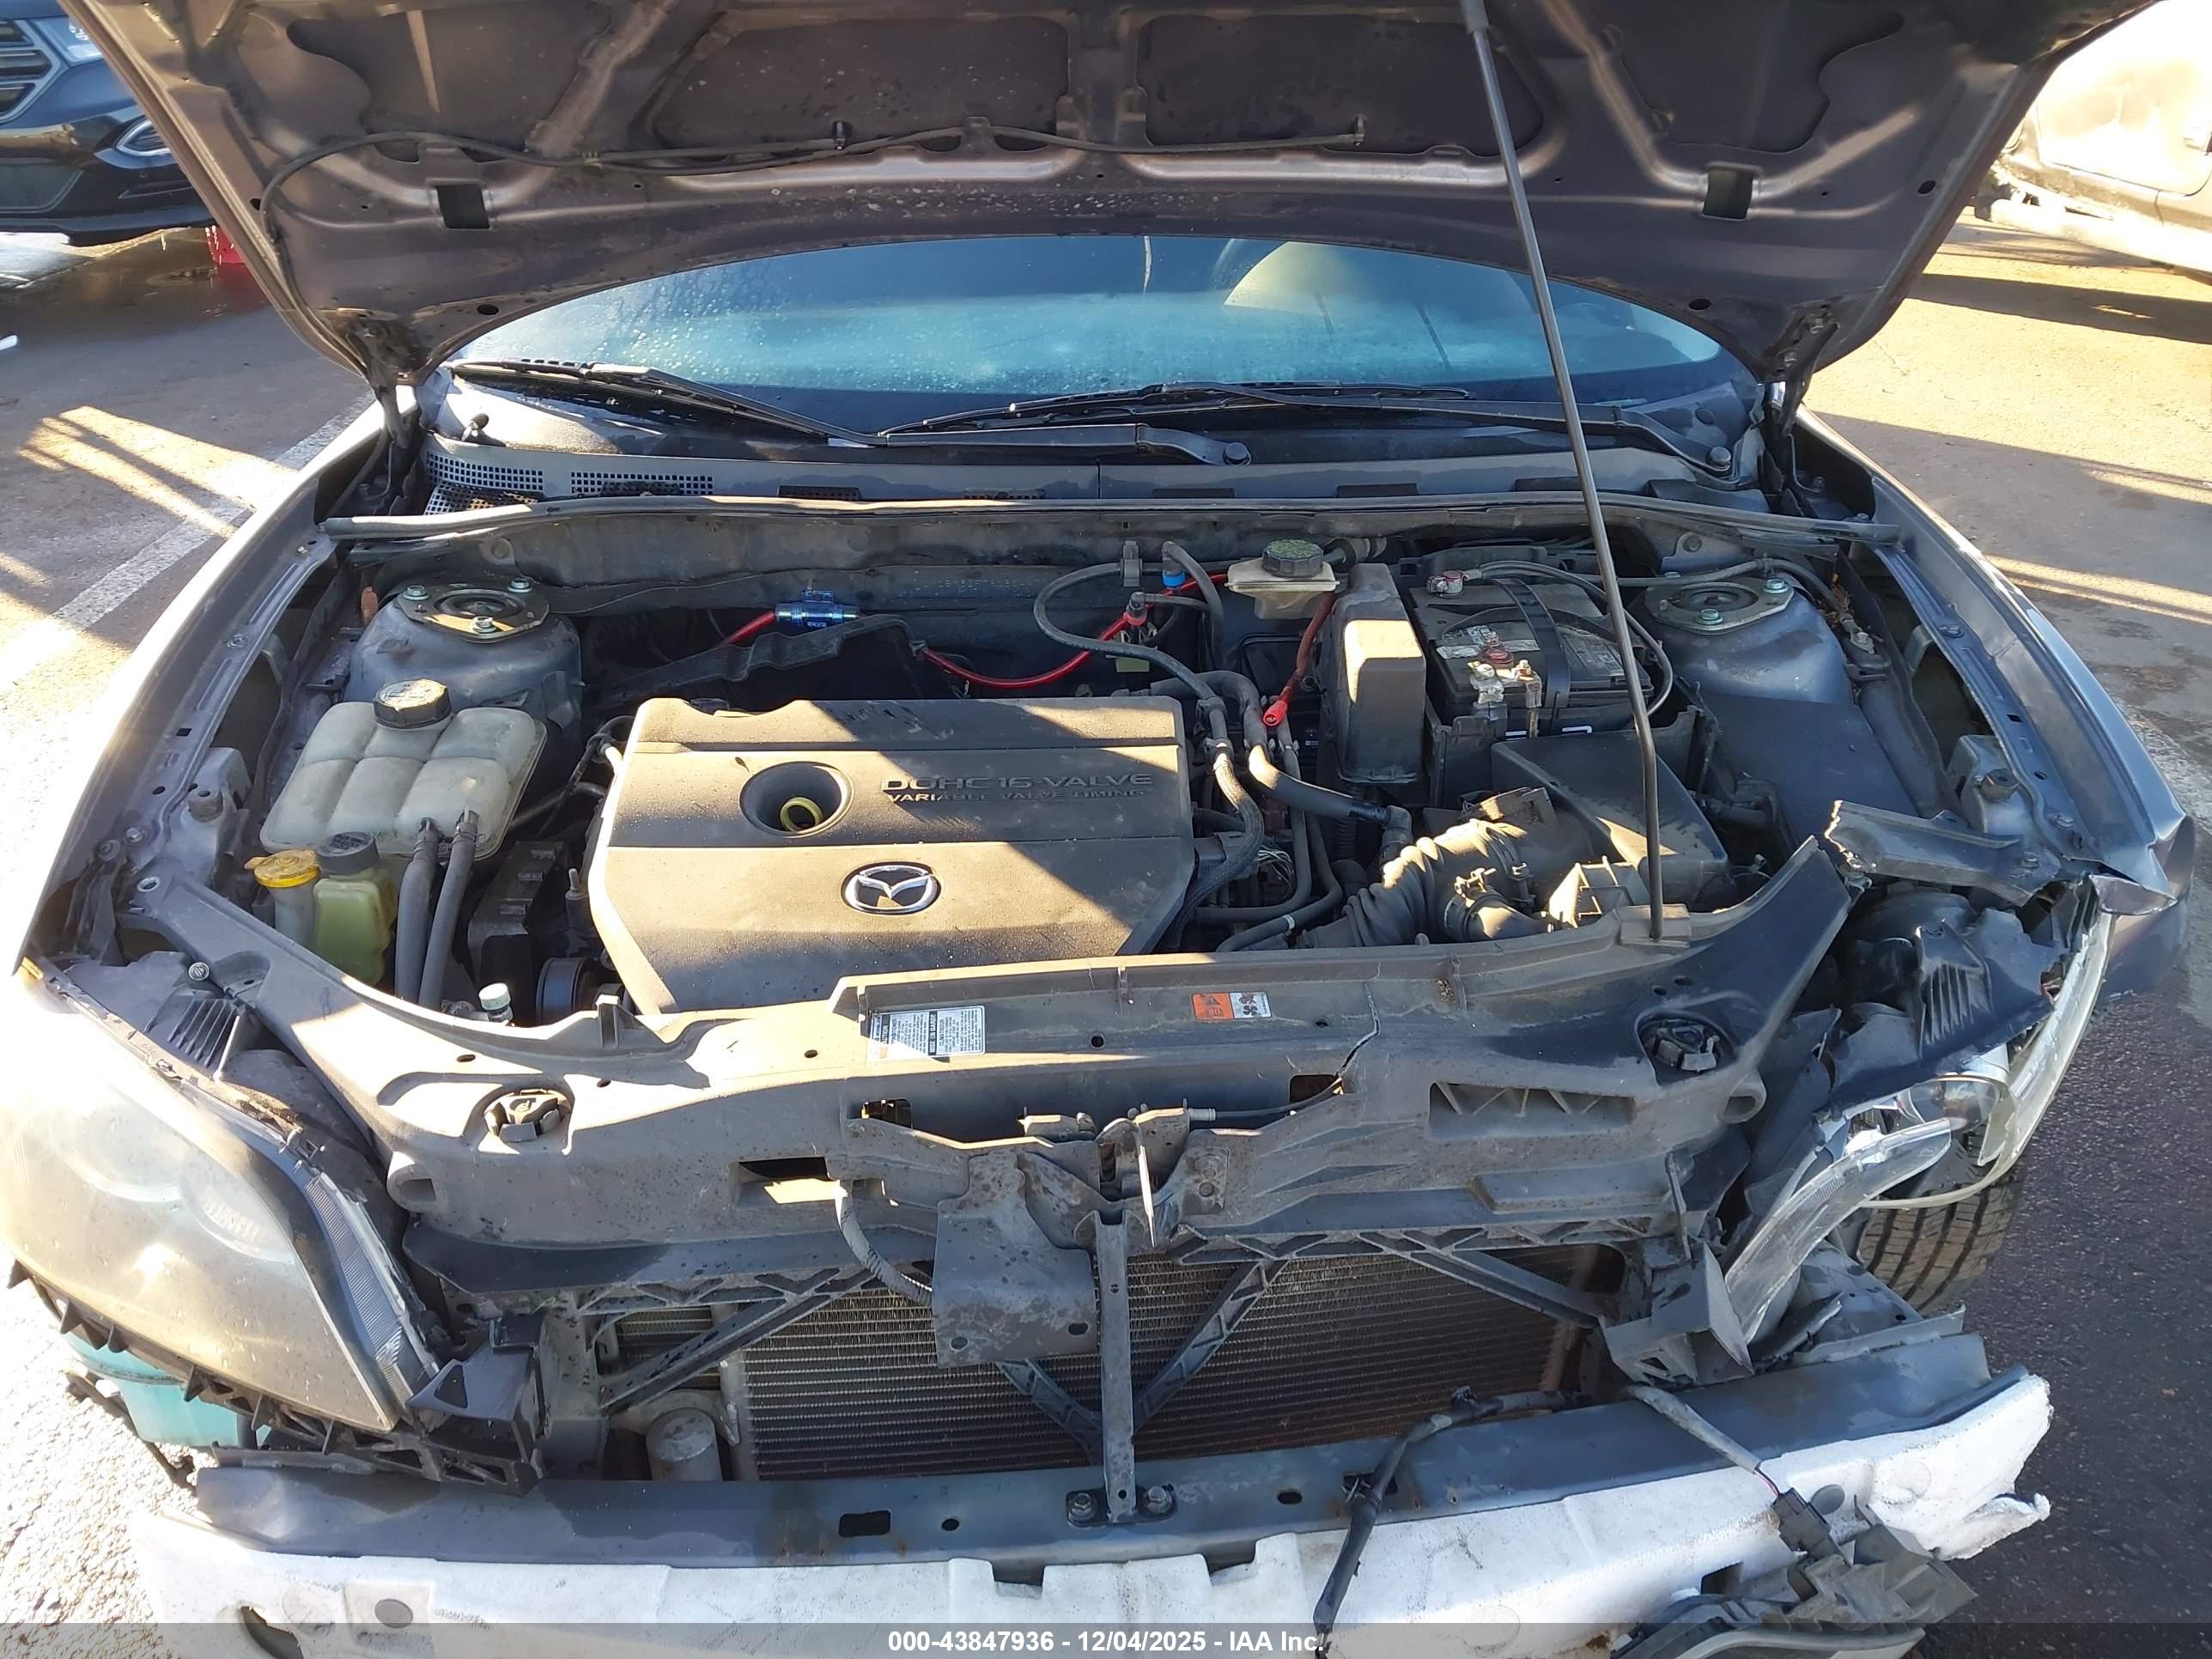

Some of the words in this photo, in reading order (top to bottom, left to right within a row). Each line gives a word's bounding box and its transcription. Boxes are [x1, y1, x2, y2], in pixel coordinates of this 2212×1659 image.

[882, 775, 990, 792] DOHC
[998, 773, 1152, 788] 16-VALVE
[889, 792, 989, 803] VARIABLE
[1003, 790, 1066, 800] VALVE
[1073, 787, 1146, 799] TIMING
